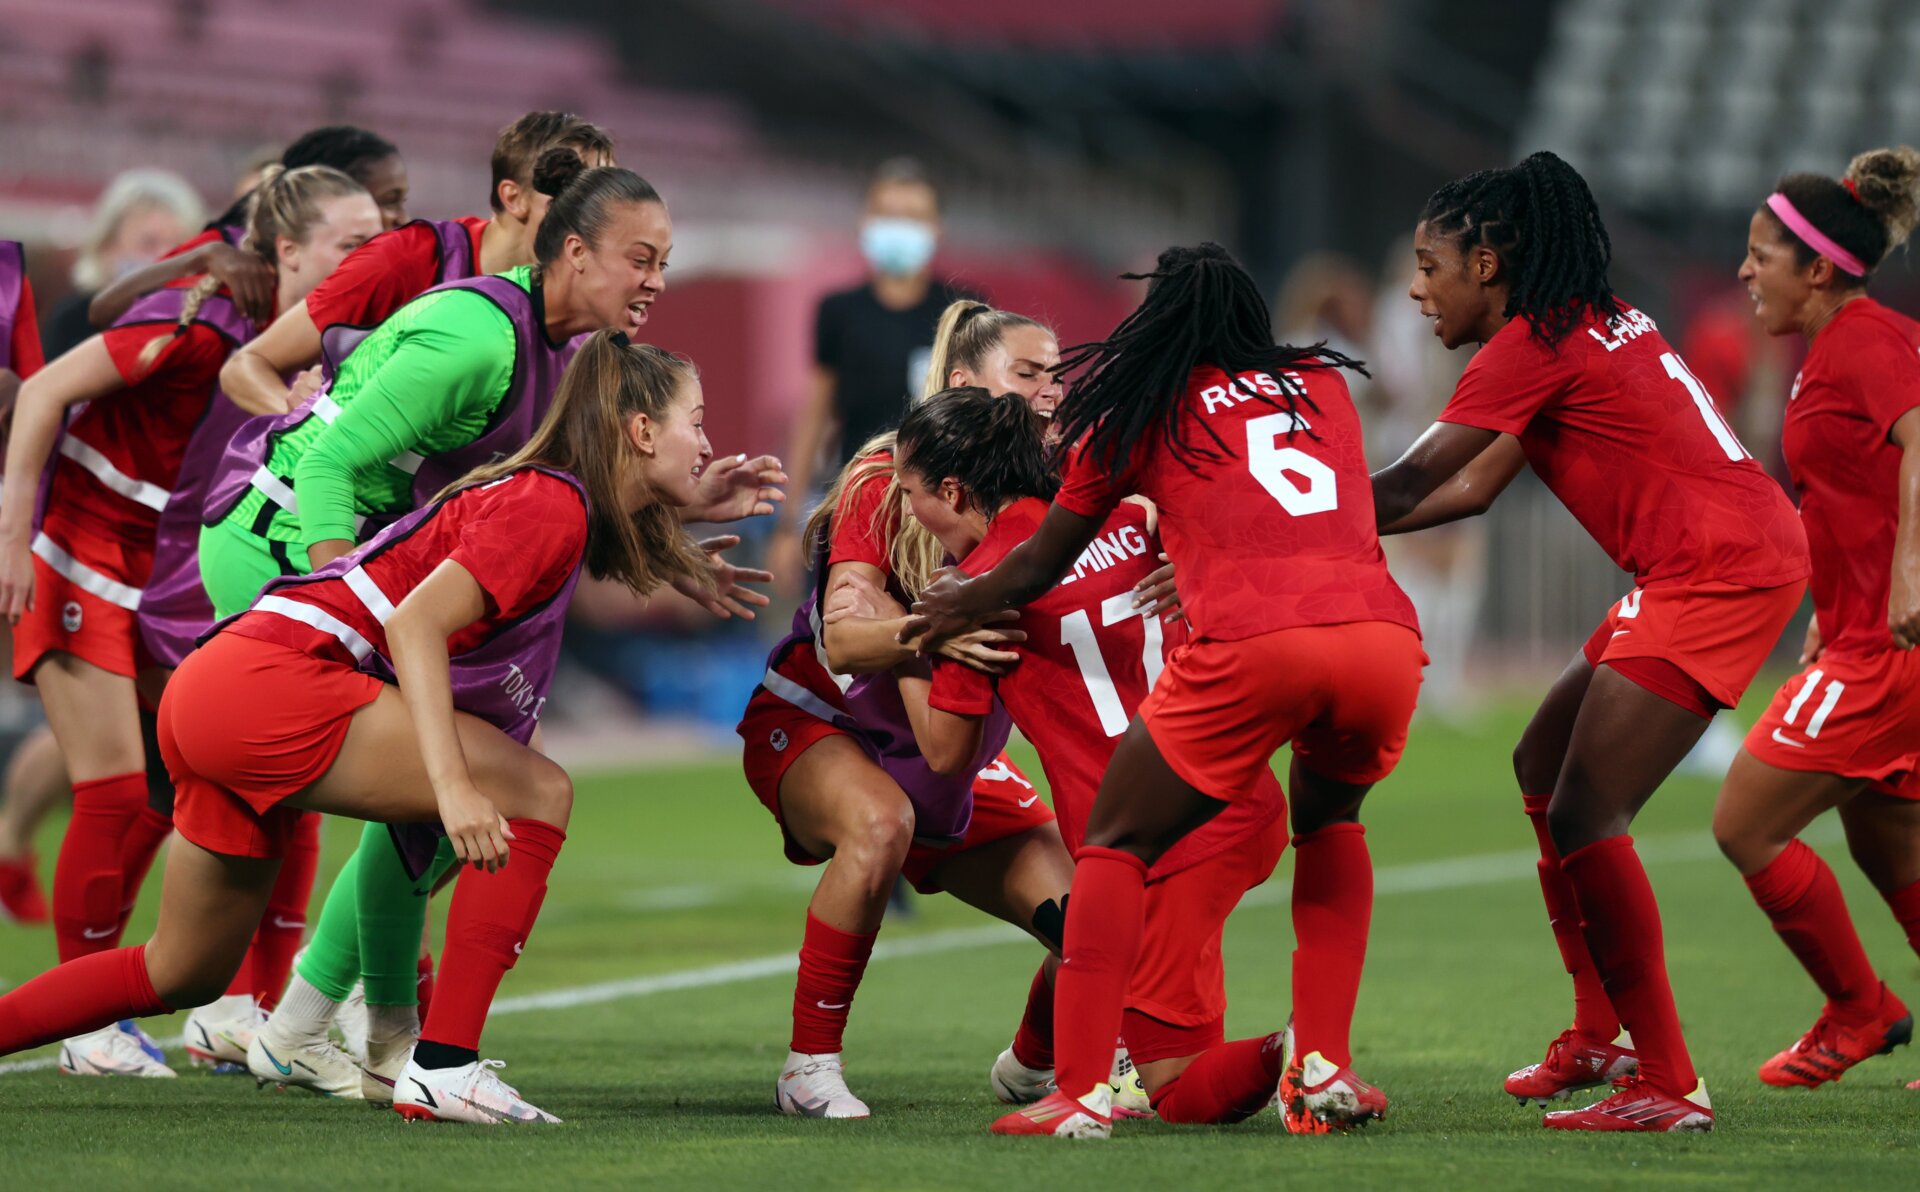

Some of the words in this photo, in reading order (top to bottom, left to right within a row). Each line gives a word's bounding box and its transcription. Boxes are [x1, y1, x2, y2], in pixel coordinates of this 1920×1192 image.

[1587, 308, 1658, 352] LAWR
[1200, 371, 1308, 415] ROSE
[1659, 352, 1753, 462] 1
[1246, 411, 1338, 517] 6
[1061, 585, 1165, 738] 17
[1783, 669, 1845, 739] 11
